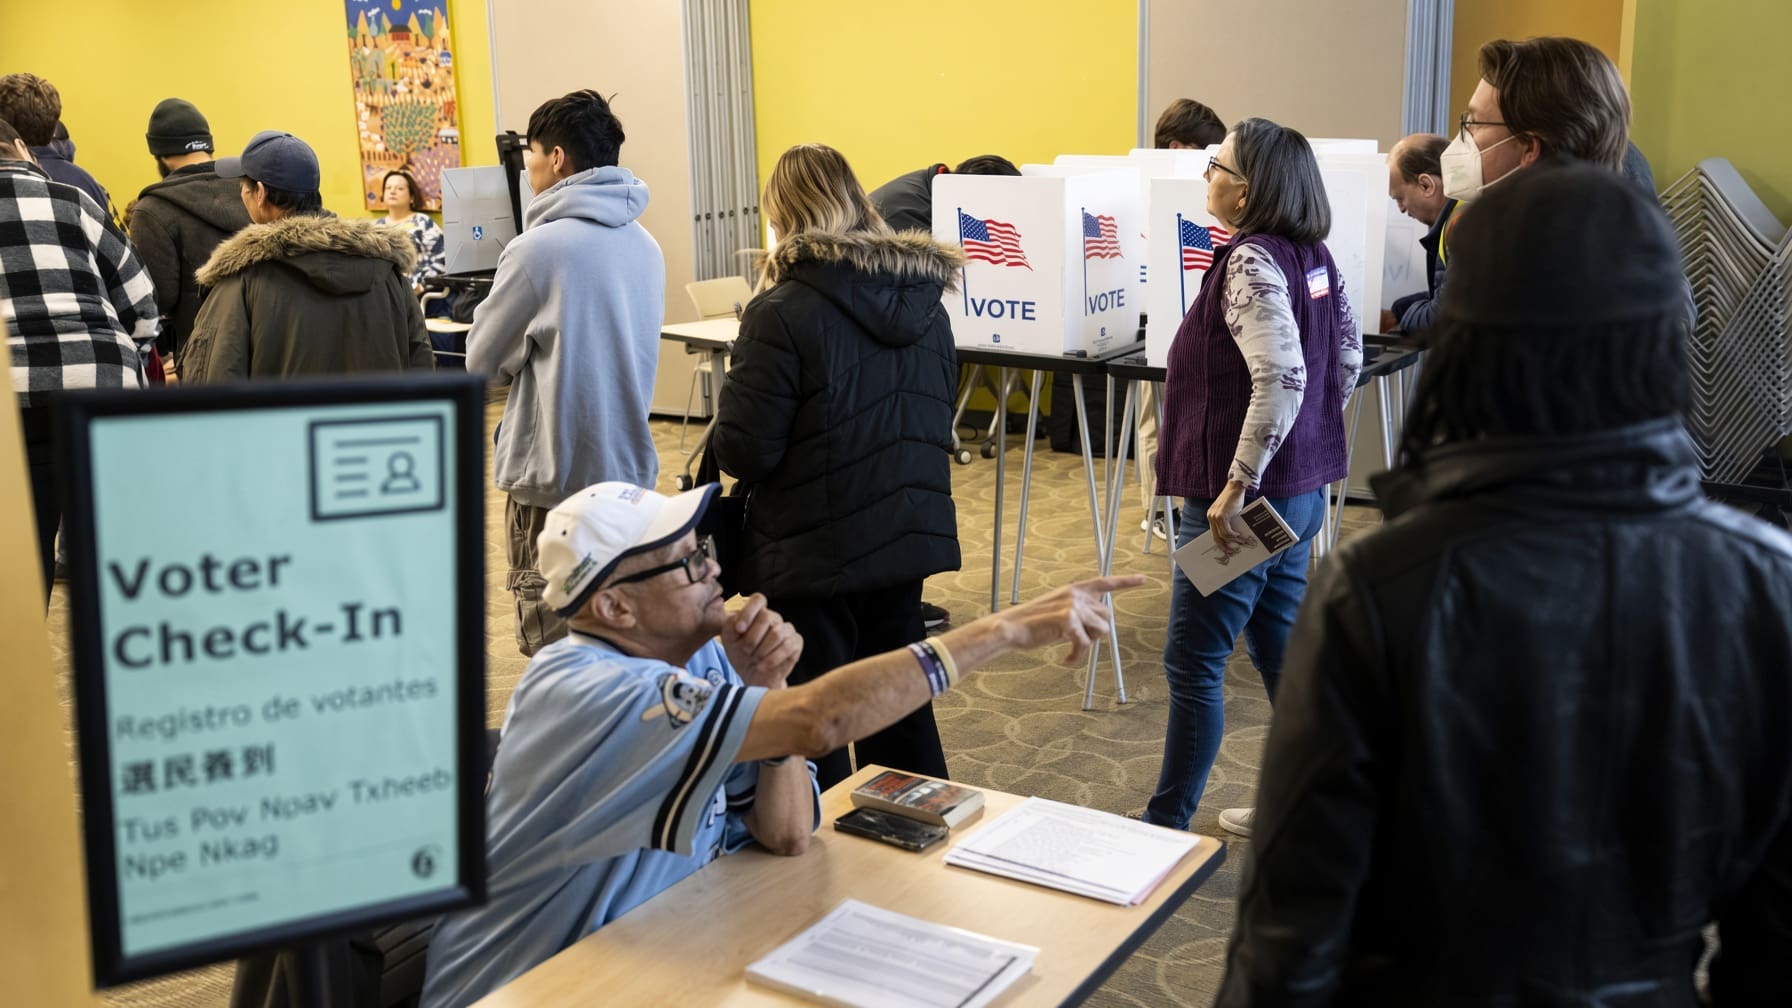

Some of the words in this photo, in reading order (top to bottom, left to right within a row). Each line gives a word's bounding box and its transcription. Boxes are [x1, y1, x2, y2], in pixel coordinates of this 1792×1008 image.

[970, 297, 1036, 321] VOTE
[1088, 288, 1126, 315] VOTE
[108, 551, 292, 602] Voter
[113, 602, 404, 671] Check-In
[116, 702, 252, 740] Registro
[262, 693, 301, 723] de
[310, 677, 438, 714] votantes
[121, 816, 180, 844] Tus
[190, 805, 248, 832] Pov
[348, 768, 452, 804] Txheeb
[124, 850, 188, 880] Npe
[200, 833, 279, 868] Nkag
